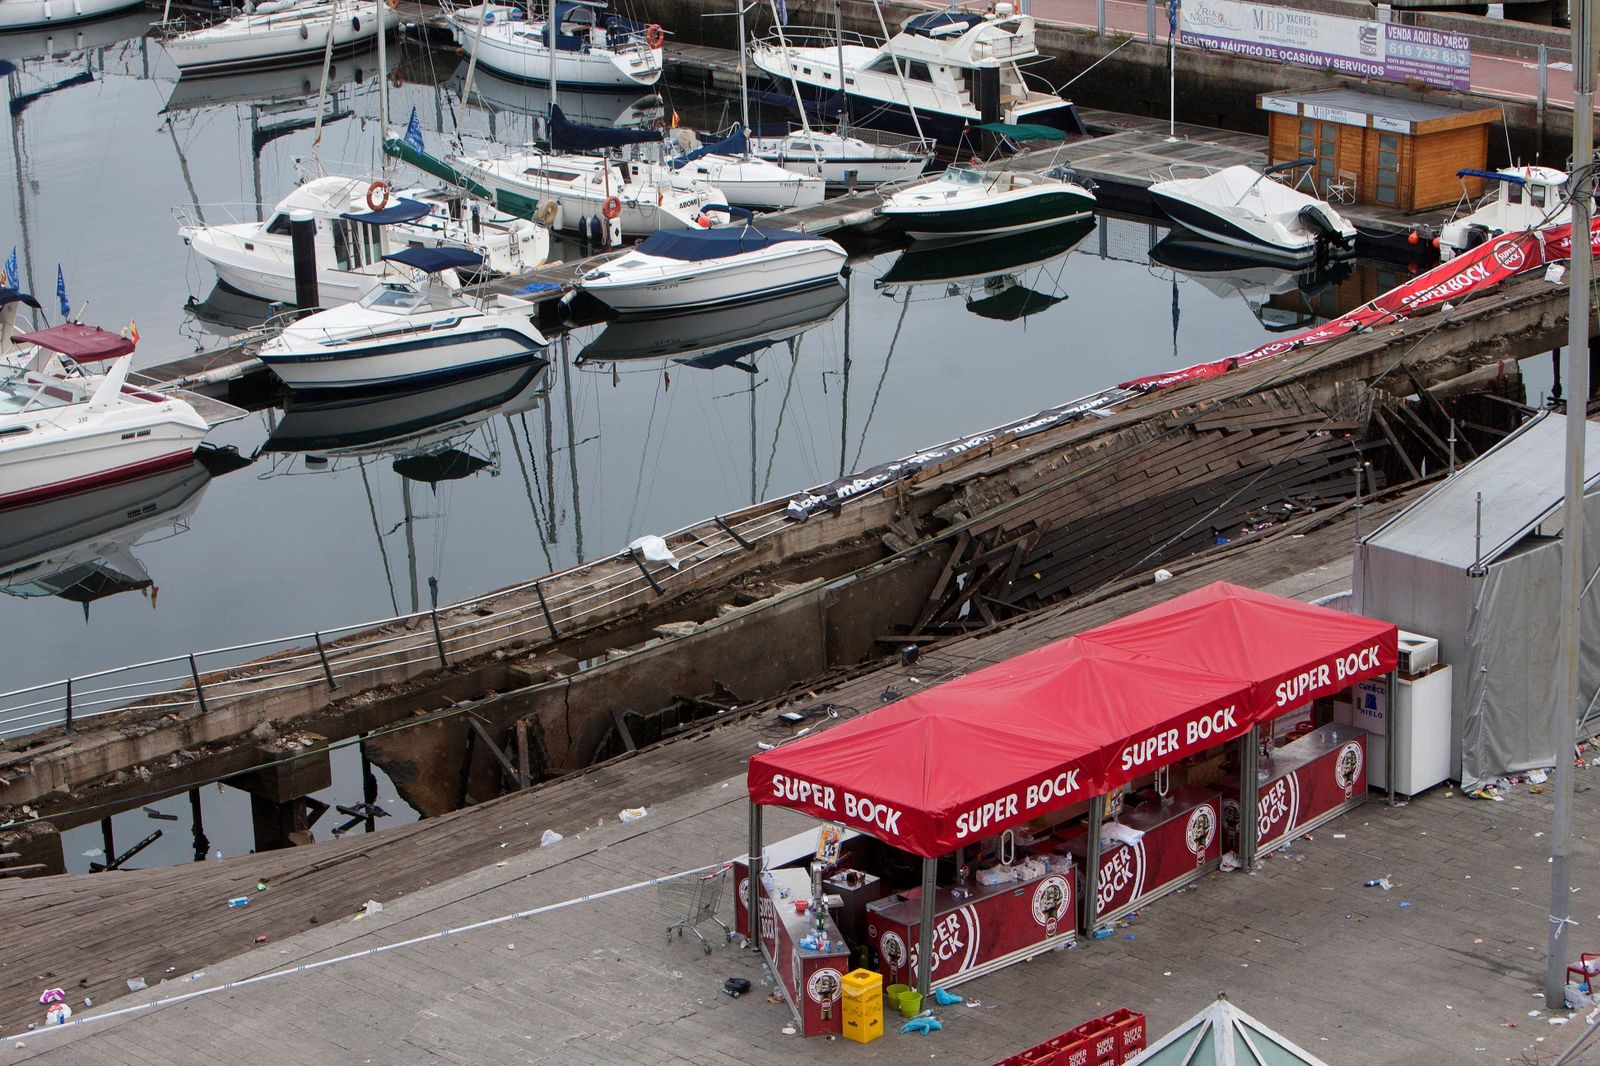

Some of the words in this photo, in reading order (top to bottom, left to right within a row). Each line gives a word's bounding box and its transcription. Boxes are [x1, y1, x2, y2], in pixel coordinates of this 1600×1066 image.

[1253, 8, 1284, 32] MBP
[1286, 13, 1312, 26] YACHTS
[1286, 26, 1319, 39] SERVICES
[1387, 27, 1412, 41] VENDA
[1433, 33, 1442, 46] SU
[1182, 34, 1218, 49] CENTRO
[1220, 40, 1263, 56] NÁUTICO
[1265, 48, 1278, 58] DE
[1279, 50, 1322, 64] OCASIÓN
[1324, 56, 1331, 67] Y
[1333, 58, 1385, 76] SERVICIOS
[1389, 42, 1412, 56] 616
[1417, 47, 1439, 60] 732
[1401, 284, 1454, 308] SUPER
[1447, 261, 1490, 291] BOCK
[1275, 664, 1331, 706] SUPER
[1336, 645, 1381, 680] BOCK
[1121, 728, 1180, 771] SUPER
[1186, 705, 1238, 745] BOCK
[772, 774, 836, 812] SUPER
[844, 792, 902, 836] BOCK
[956, 793, 1018, 838] SUPER
[1026, 768, 1080, 809] BOCK
[1123, 1025, 1142, 1038] SUPER
[1124, 1033, 1142, 1046] BOCK
[1096, 1036, 1115, 1049] SUPER
[1097, 1044, 1114, 1057] BOCK
[1068, 1049, 1087, 1062] SUPER
